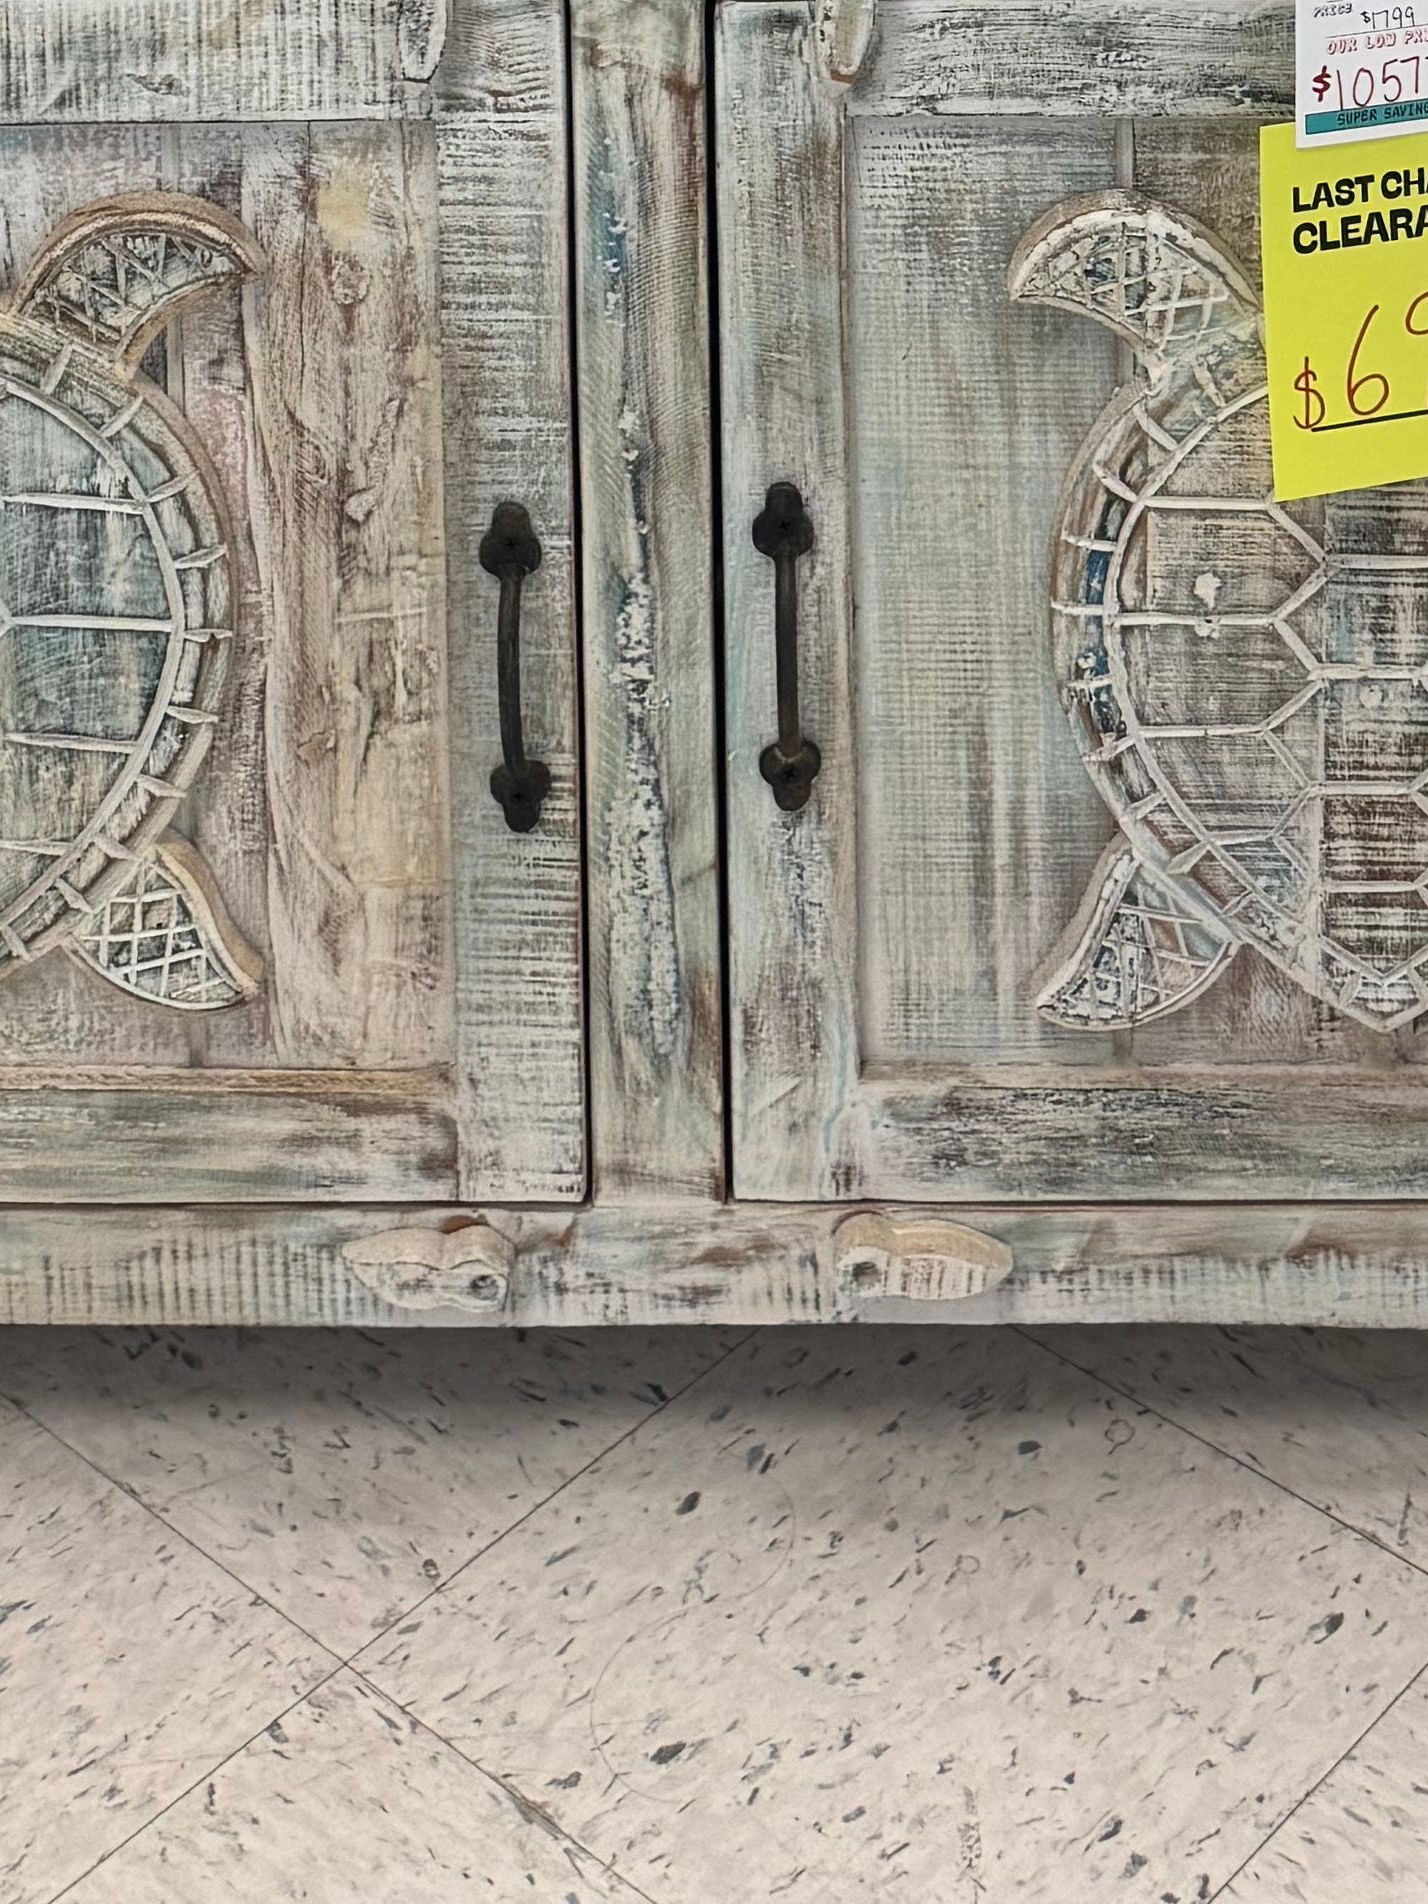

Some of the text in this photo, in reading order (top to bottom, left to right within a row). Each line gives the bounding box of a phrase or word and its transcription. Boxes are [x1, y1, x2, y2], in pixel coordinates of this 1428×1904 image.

[1326, 39, 1358, 55] OUR
[1366, 33, 1397, 51] LOW
[1337, 108, 1377, 126] SUPER
[1292, 175, 1375, 213] LAST
